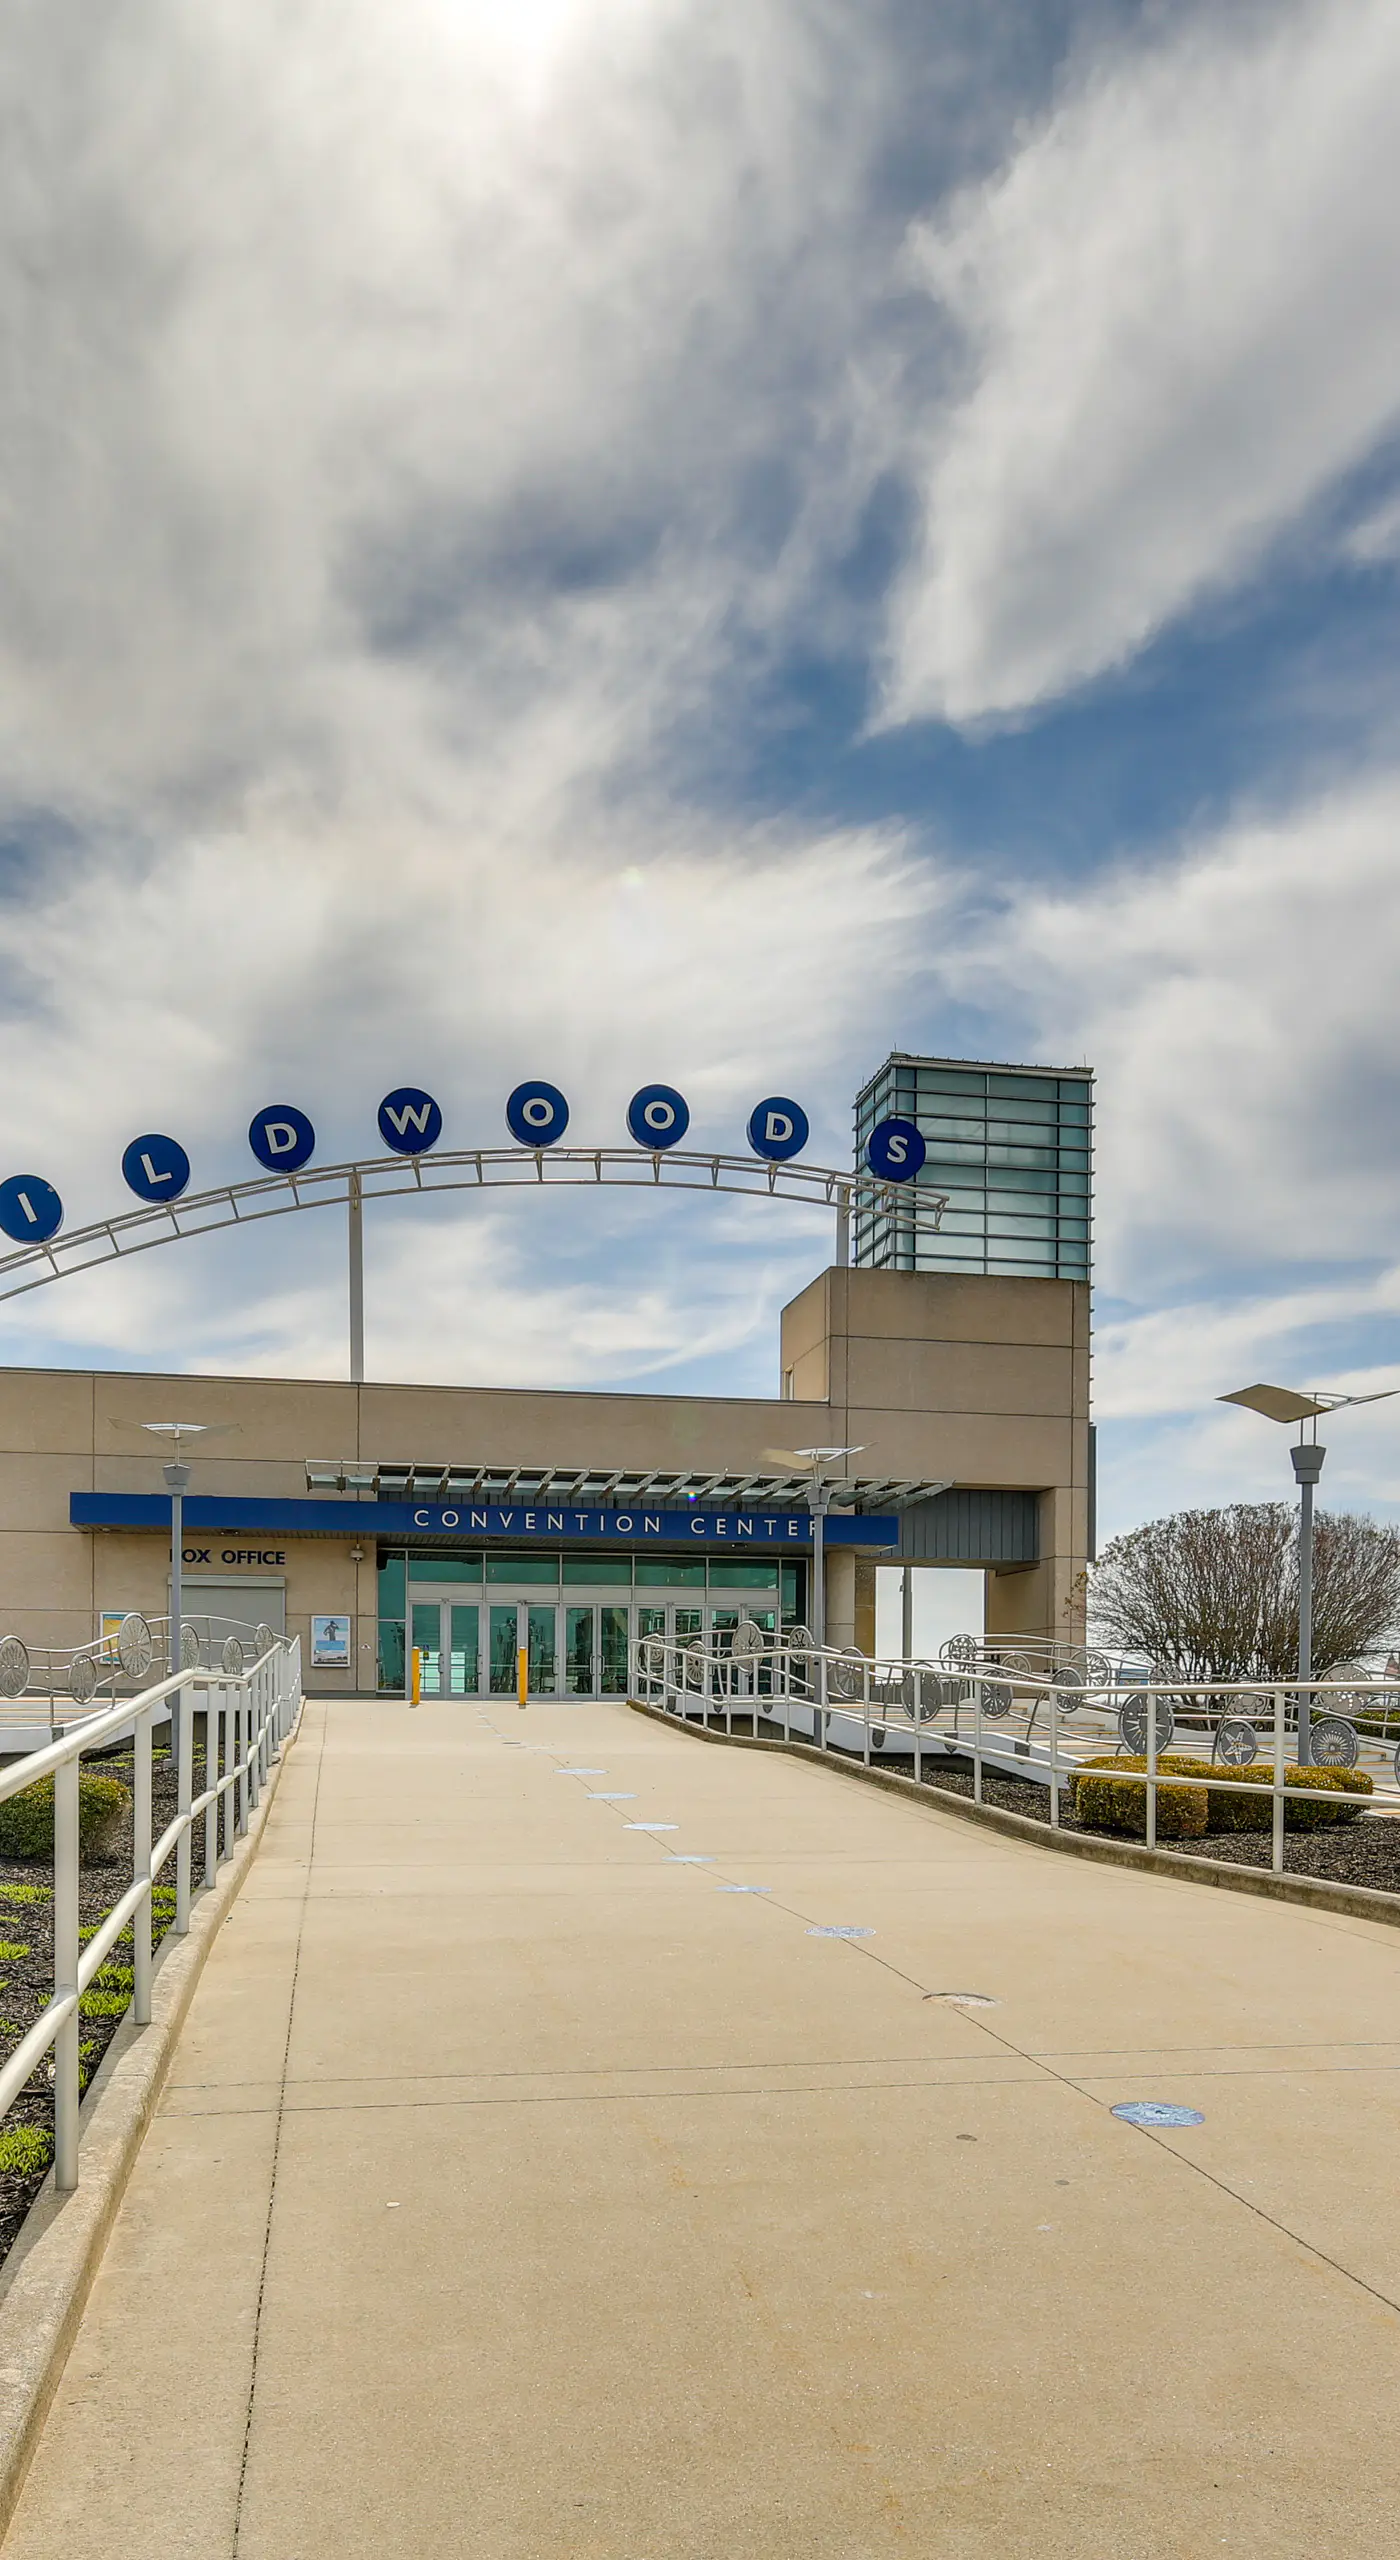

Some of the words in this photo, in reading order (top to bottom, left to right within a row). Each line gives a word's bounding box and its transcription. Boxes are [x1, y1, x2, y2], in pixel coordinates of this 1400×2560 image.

[413, 1509, 661, 1534] CONVENTION
[169, 1548, 212, 1564] OX
[221, 1549, 286, 1566] OFFICE
